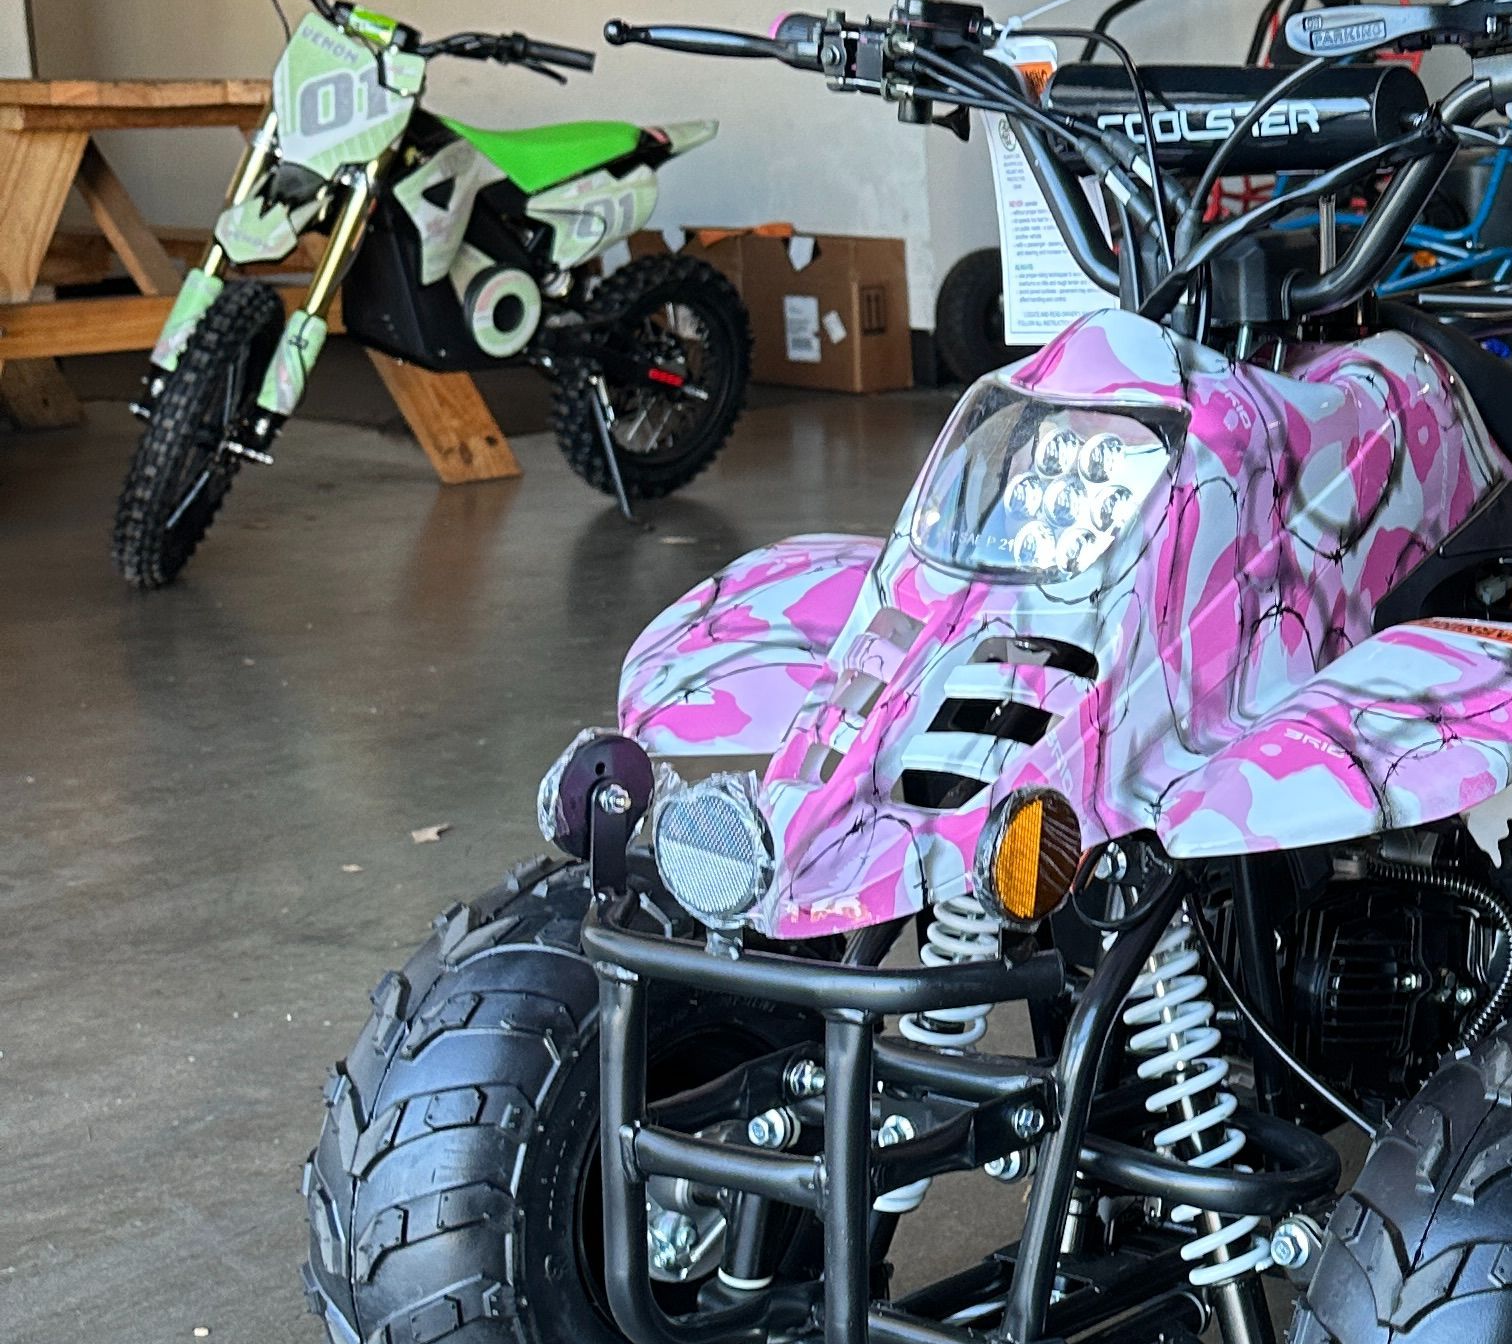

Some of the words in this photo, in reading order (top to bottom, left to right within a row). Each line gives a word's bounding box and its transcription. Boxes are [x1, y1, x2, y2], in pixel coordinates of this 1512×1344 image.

[302, 26, 360, 63] VENOM
[1311, 22, 1384, 49] PARKING
[299, 67, 390, 137] 01
[576, 191, 635, 237] 01
